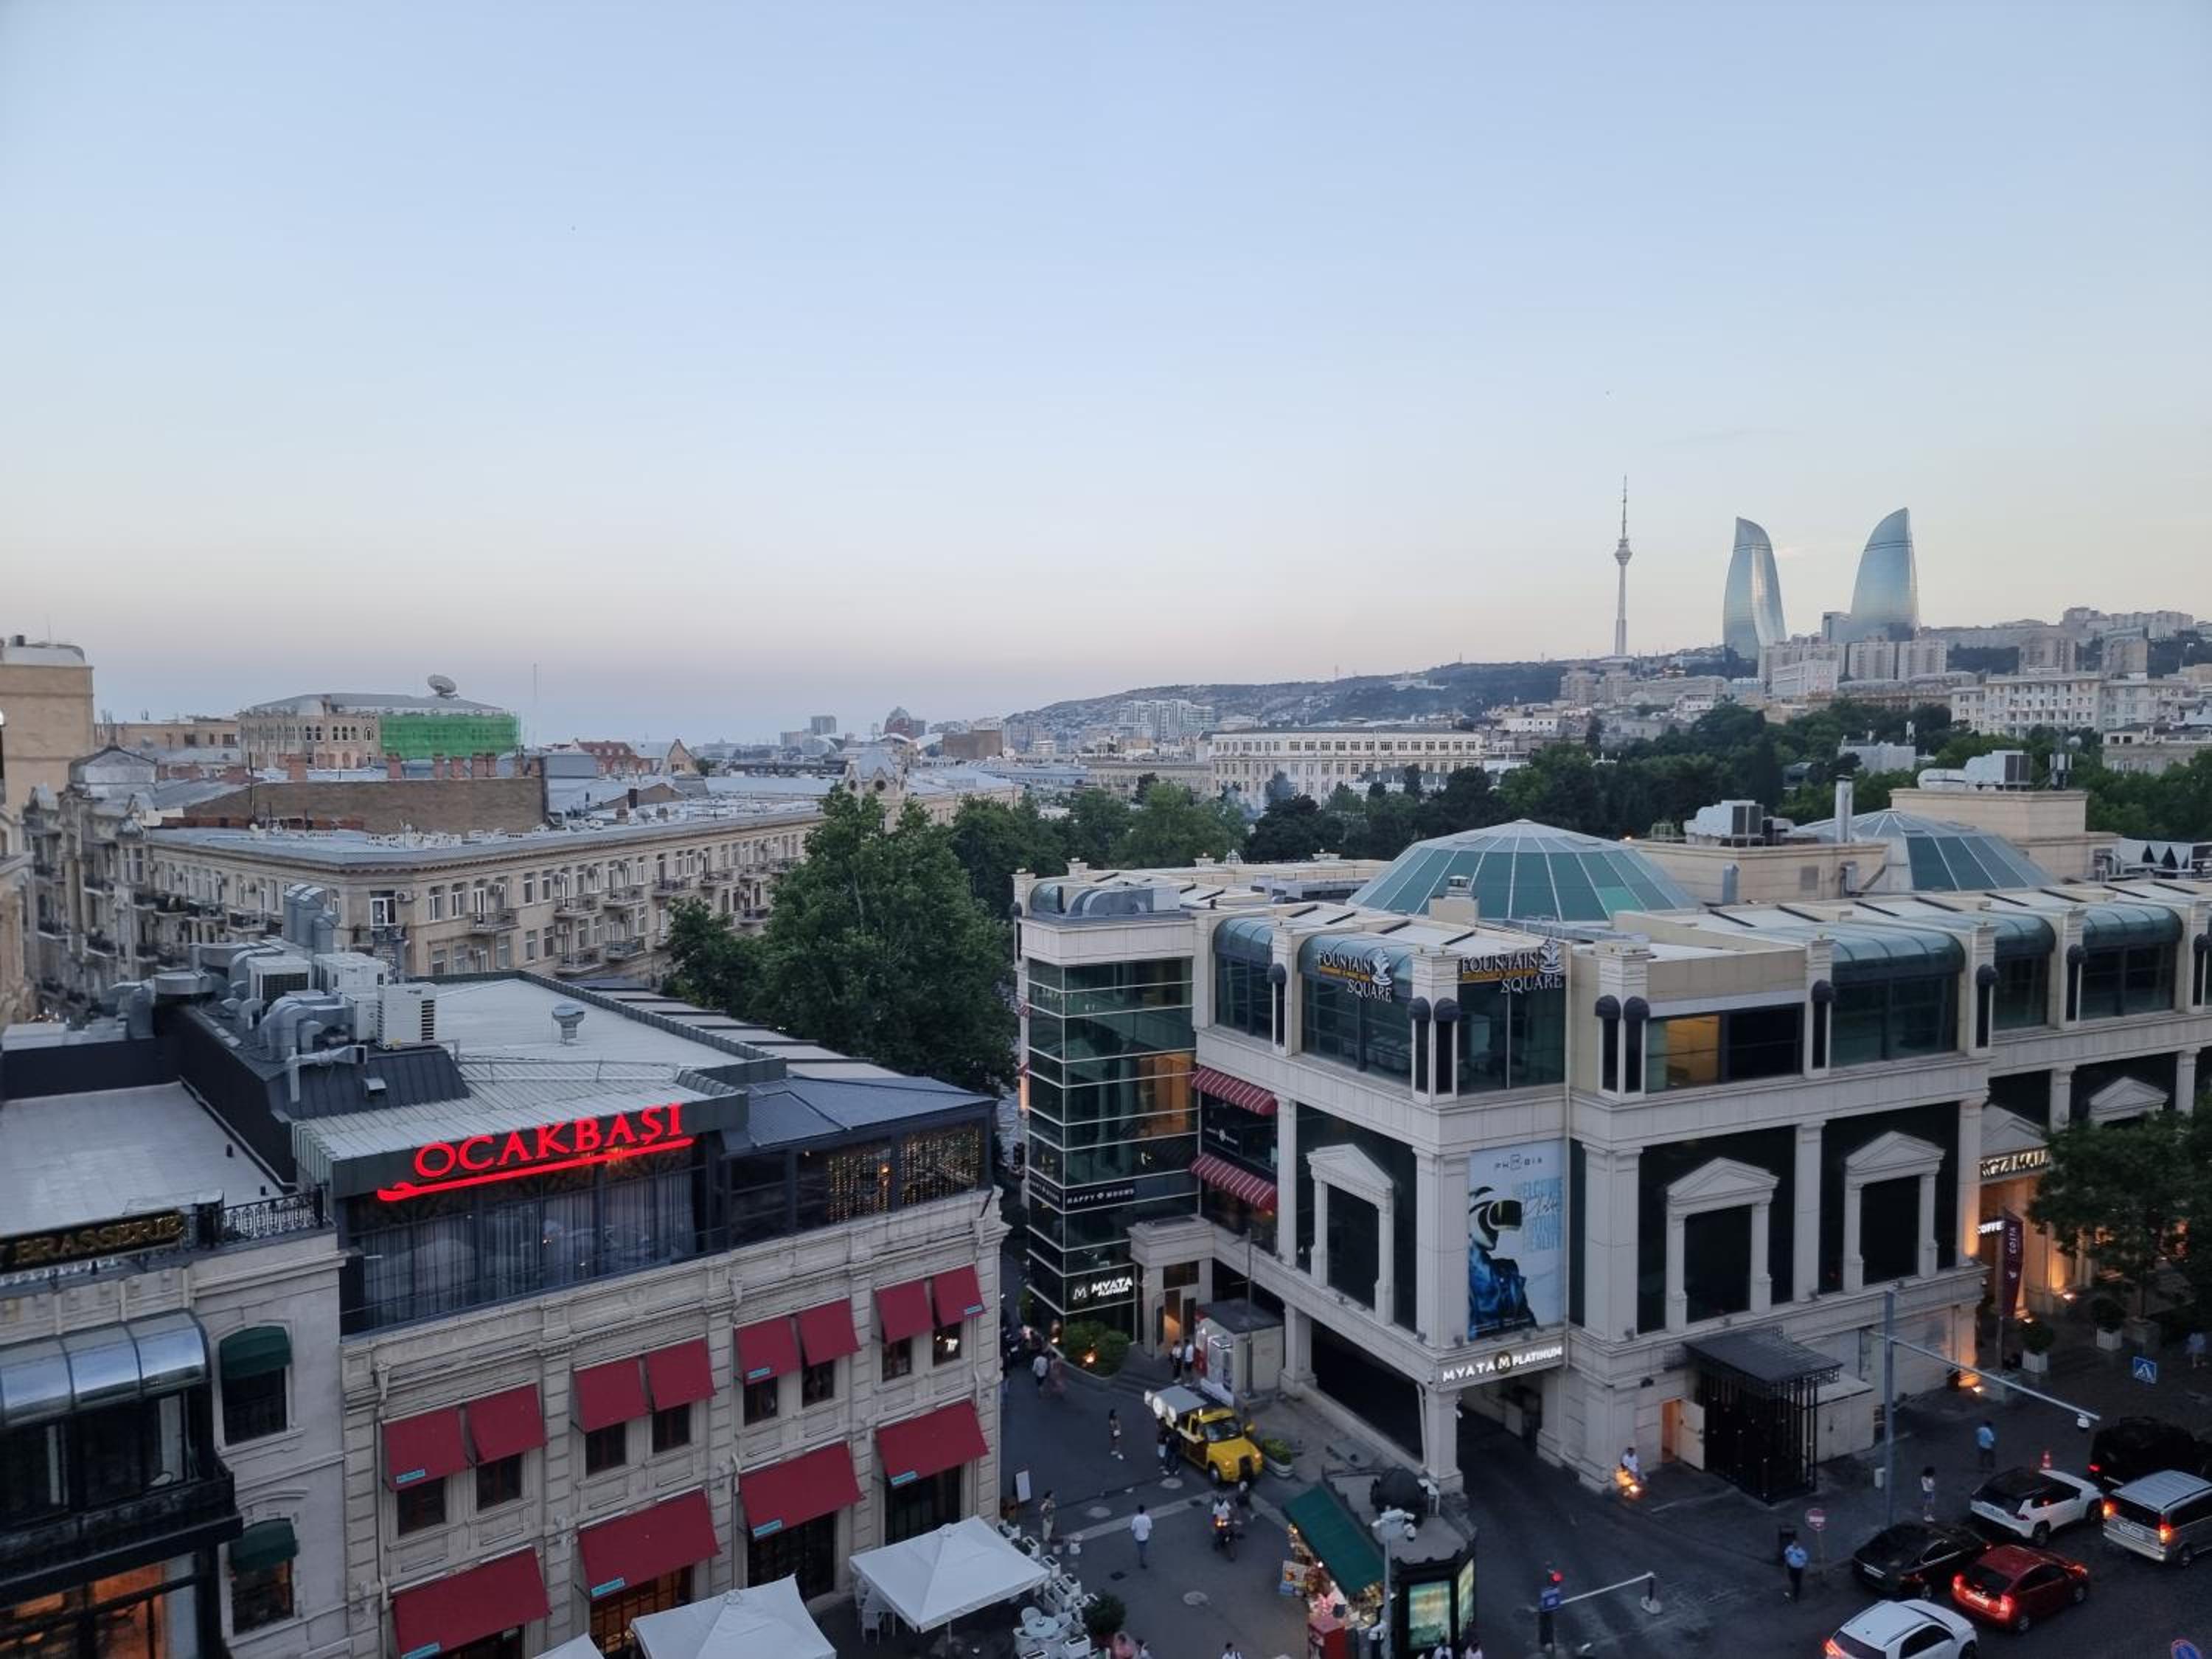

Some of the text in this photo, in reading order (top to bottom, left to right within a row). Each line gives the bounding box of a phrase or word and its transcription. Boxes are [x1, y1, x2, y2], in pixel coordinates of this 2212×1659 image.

[1315, 951, 1371, 974] FOUNTAIN
[1462, 951, 1537, 973] FOUNTAIN
[1347, 978, 1392, 1004] SQUARE
[1500, 974, 1562, 993] SQUARE
[414, 1102, 684, 1178] OCAKBAŞI
[1067, 1194, 1096, 1204] HAPPY
[15, 1214, 184, 1263] BRASSERIE
[1091, 1276, 1133, 1294] MYATA
[1443, 1361, 1495, 1382] MYATA
[1512, 1346, 1563, 1366] PLATINUM
